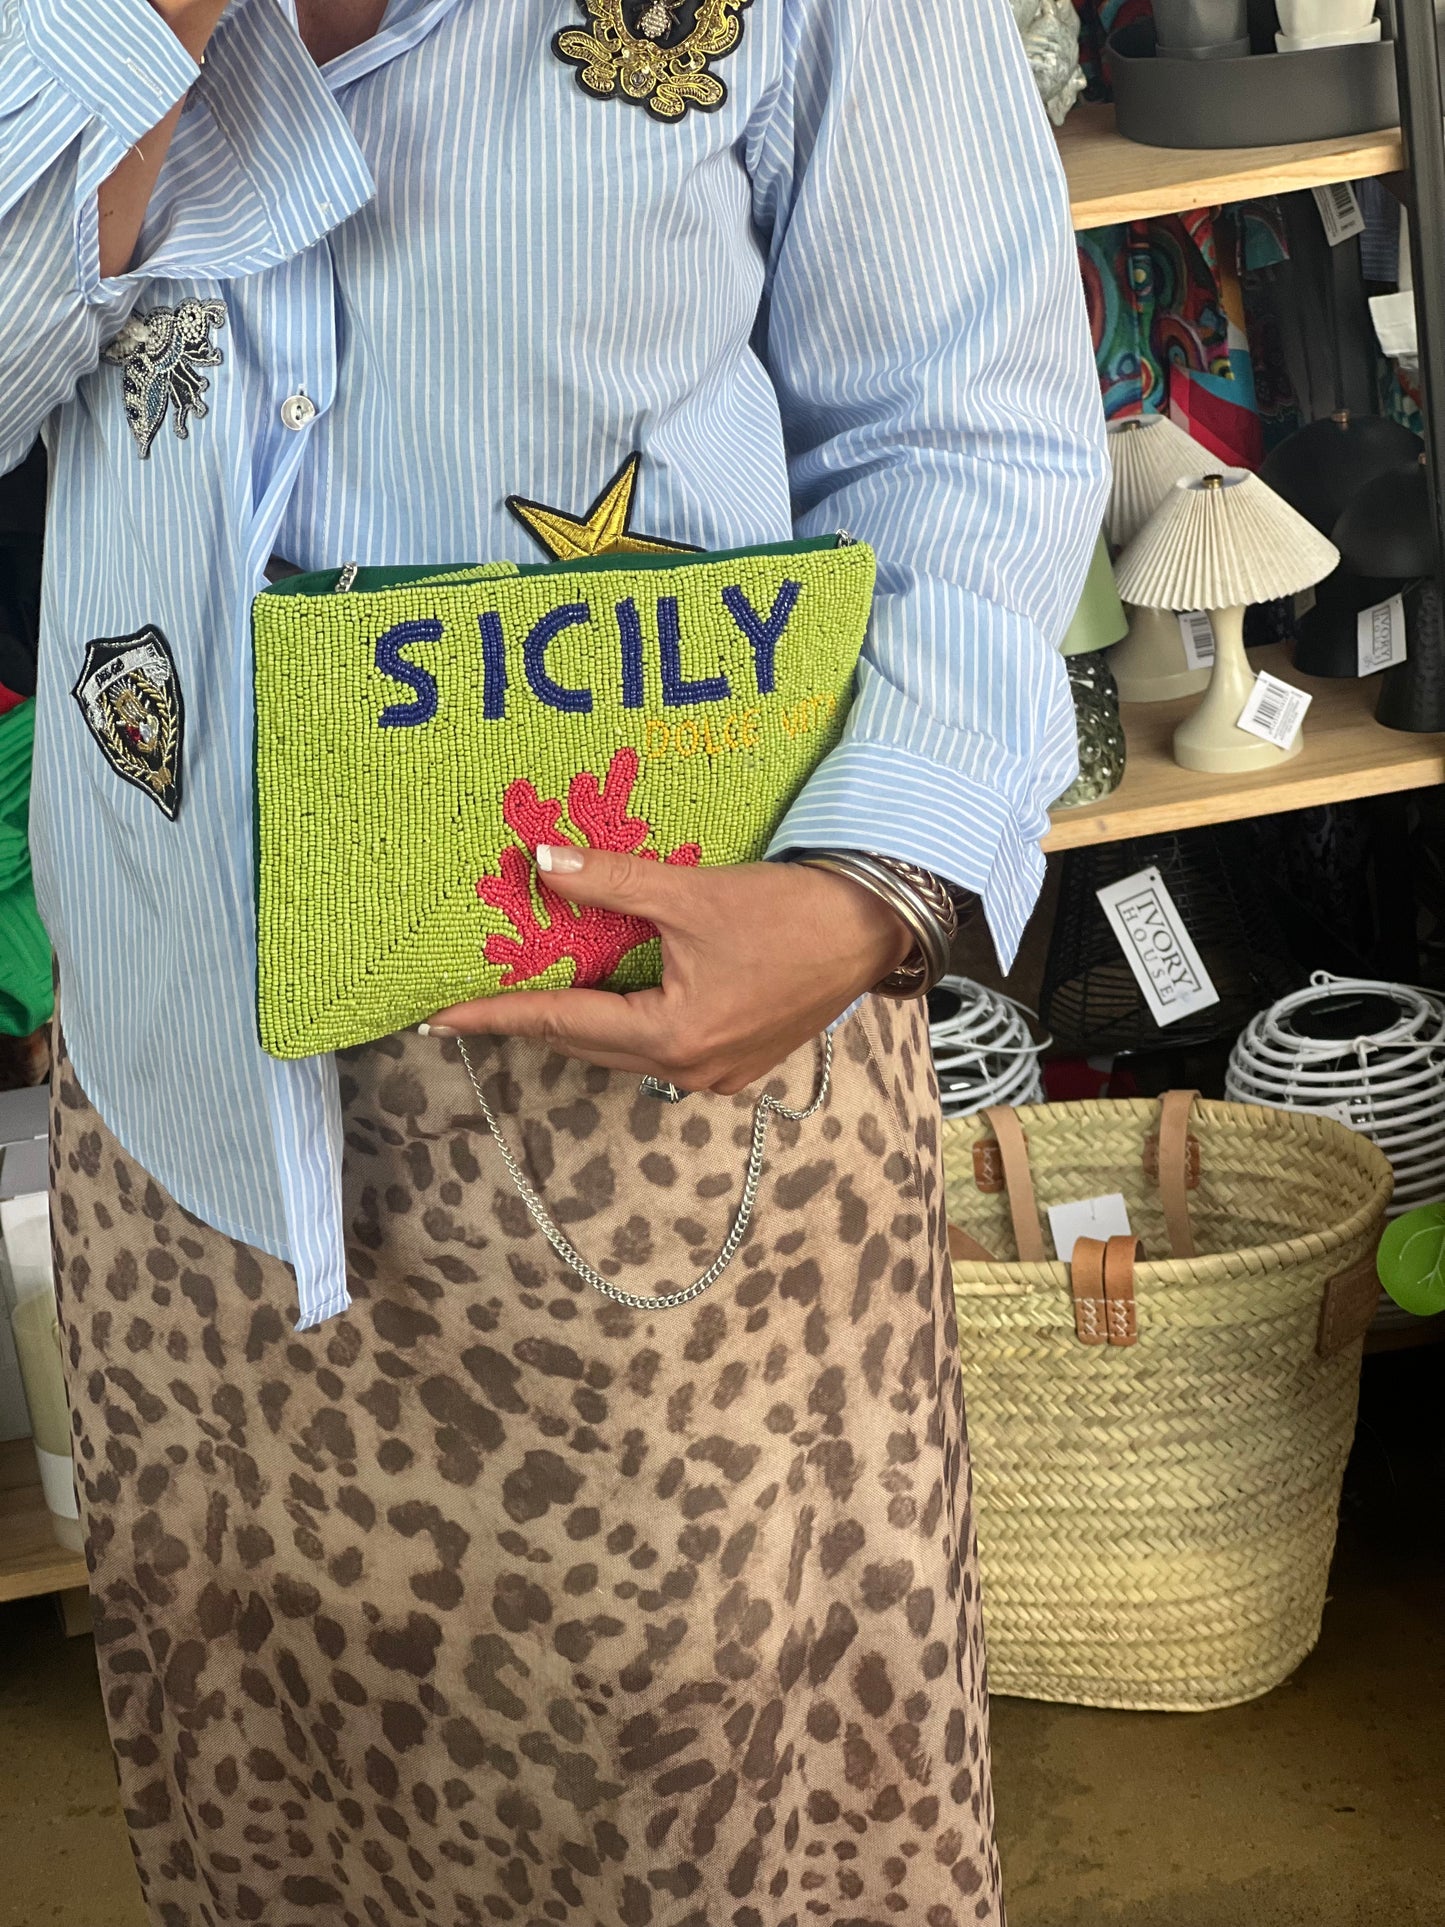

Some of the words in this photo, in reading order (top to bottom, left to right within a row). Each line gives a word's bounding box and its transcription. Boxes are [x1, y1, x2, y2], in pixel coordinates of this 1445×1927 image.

[375, 579, 802, 729] SICILY
[646, 708, 760, 759] DOLCE
[1123, 907, 1174, 998] HOUSE
[1137, 899, 1194, 987] IVORY
